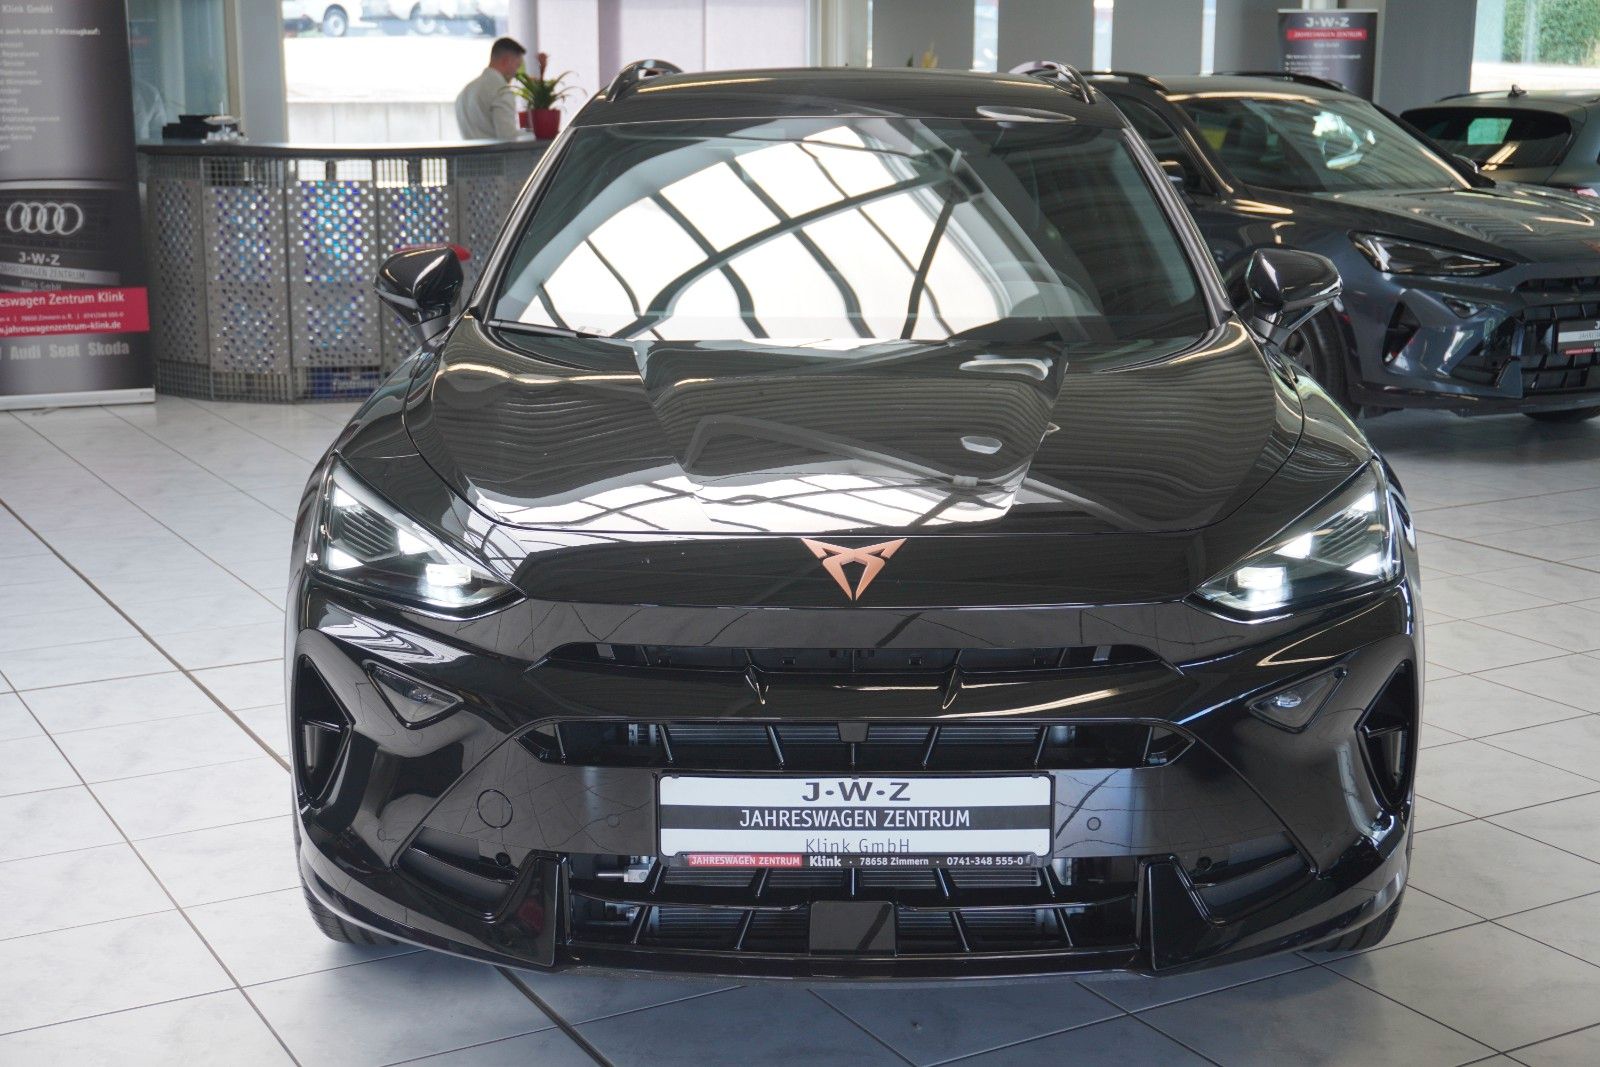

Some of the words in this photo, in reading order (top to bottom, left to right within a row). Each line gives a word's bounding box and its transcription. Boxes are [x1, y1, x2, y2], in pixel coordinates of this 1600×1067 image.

[49, 268, 86, 280] ZENTRUM
[49, 293, 95, 305] Zentrum
[97, 291, 125, 303] Klink
[10, 345, 40, 360] Audi
[48, 343, 80, 358] Seat
[88, 341, 130, 356] Skoda
[739, 809, 877, 828] JAHRESWAGEN
[883, 809, 971, 828] ZENTRUM
[805, 838, 850, 853] Klink
[859, 838, 910, 853] GmbH
[691, 856, 756, 866] JAHRESWAGEN
[758, 856, 800, 866] ZENTRUM
[809, 855, 842, 867] Klink
[860, 857, 888, 866] 78658
[890, 857, 929, 866] Zimmern
[946, 856, 993, 866] 0741-348
[995, 856, 1024, 866] 555-0
